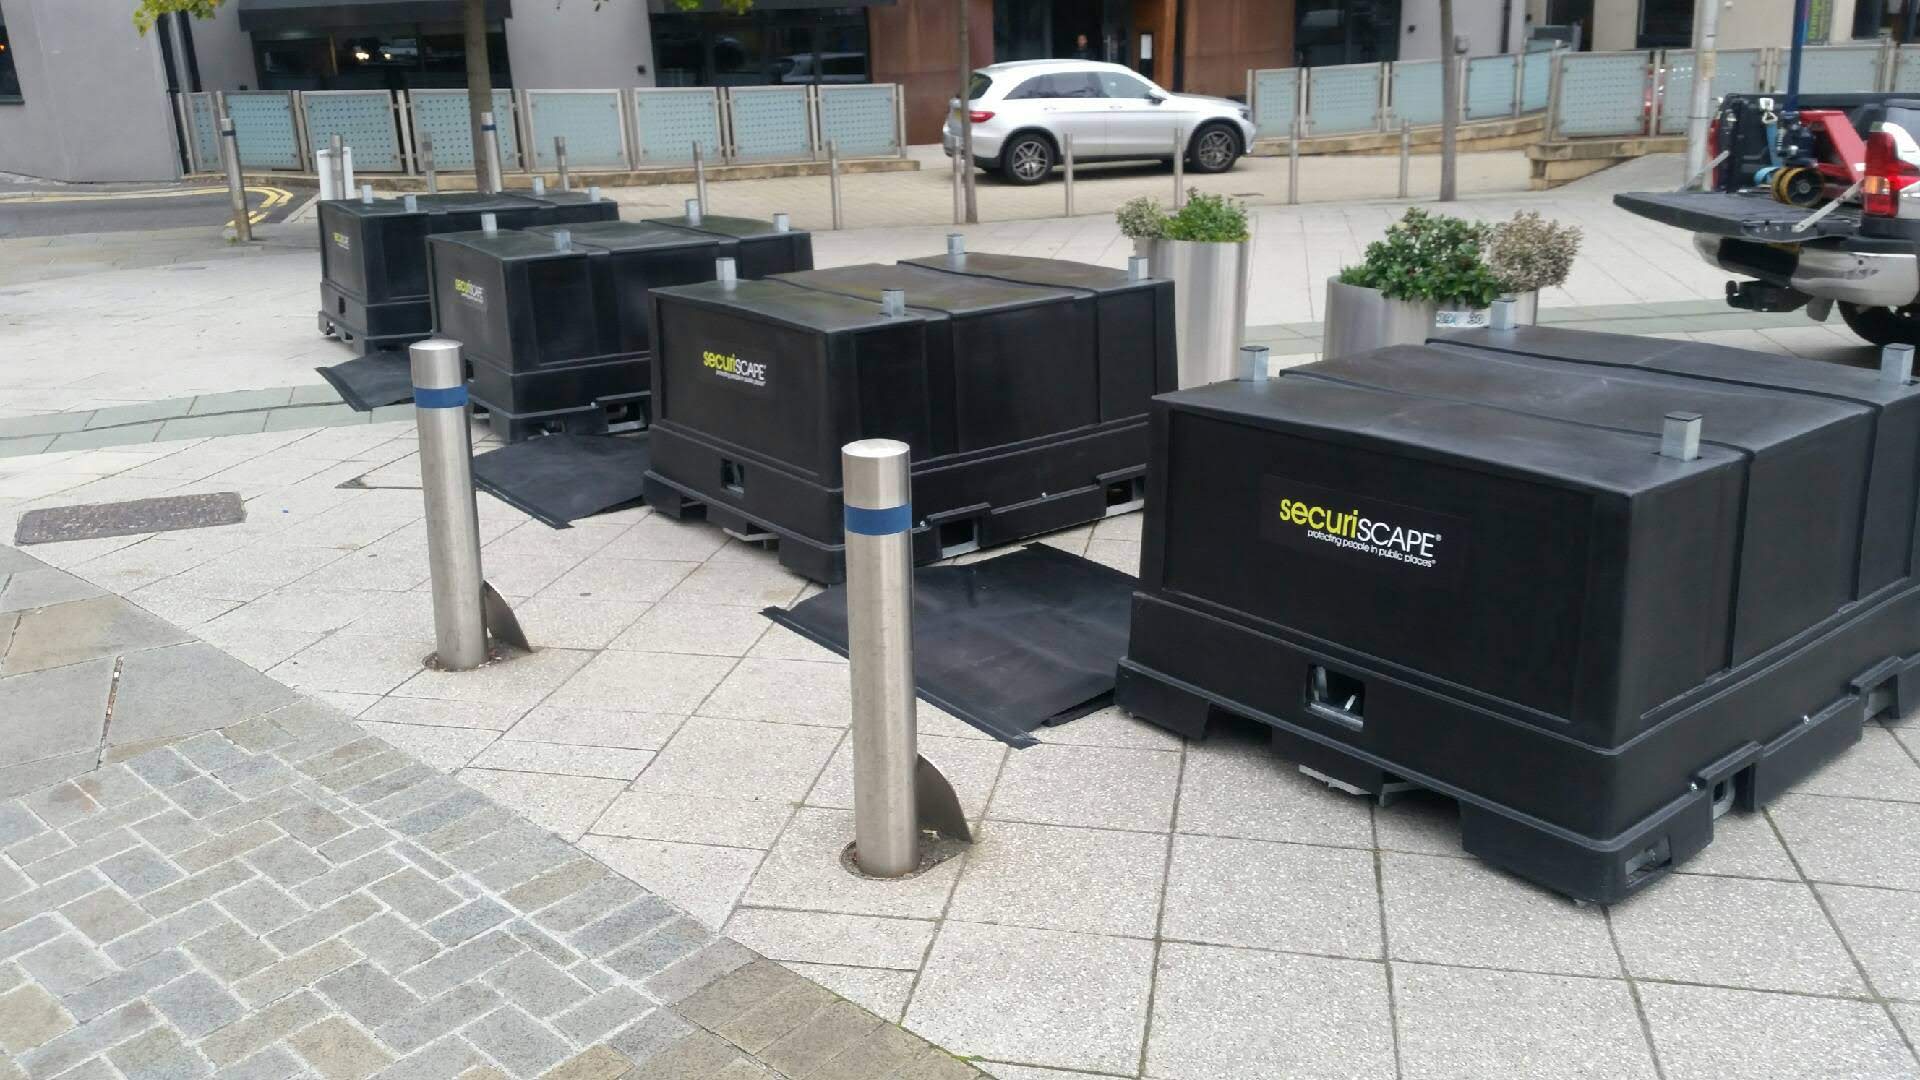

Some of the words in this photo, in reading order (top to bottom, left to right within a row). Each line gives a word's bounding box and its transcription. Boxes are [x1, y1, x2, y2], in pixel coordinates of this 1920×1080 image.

[1308, 529, 1342, 547] protecting
[1342, 539, 1370, 552] people
[1370, 544, 1378, 554] in
[1379, 549, 1403, 561] public
